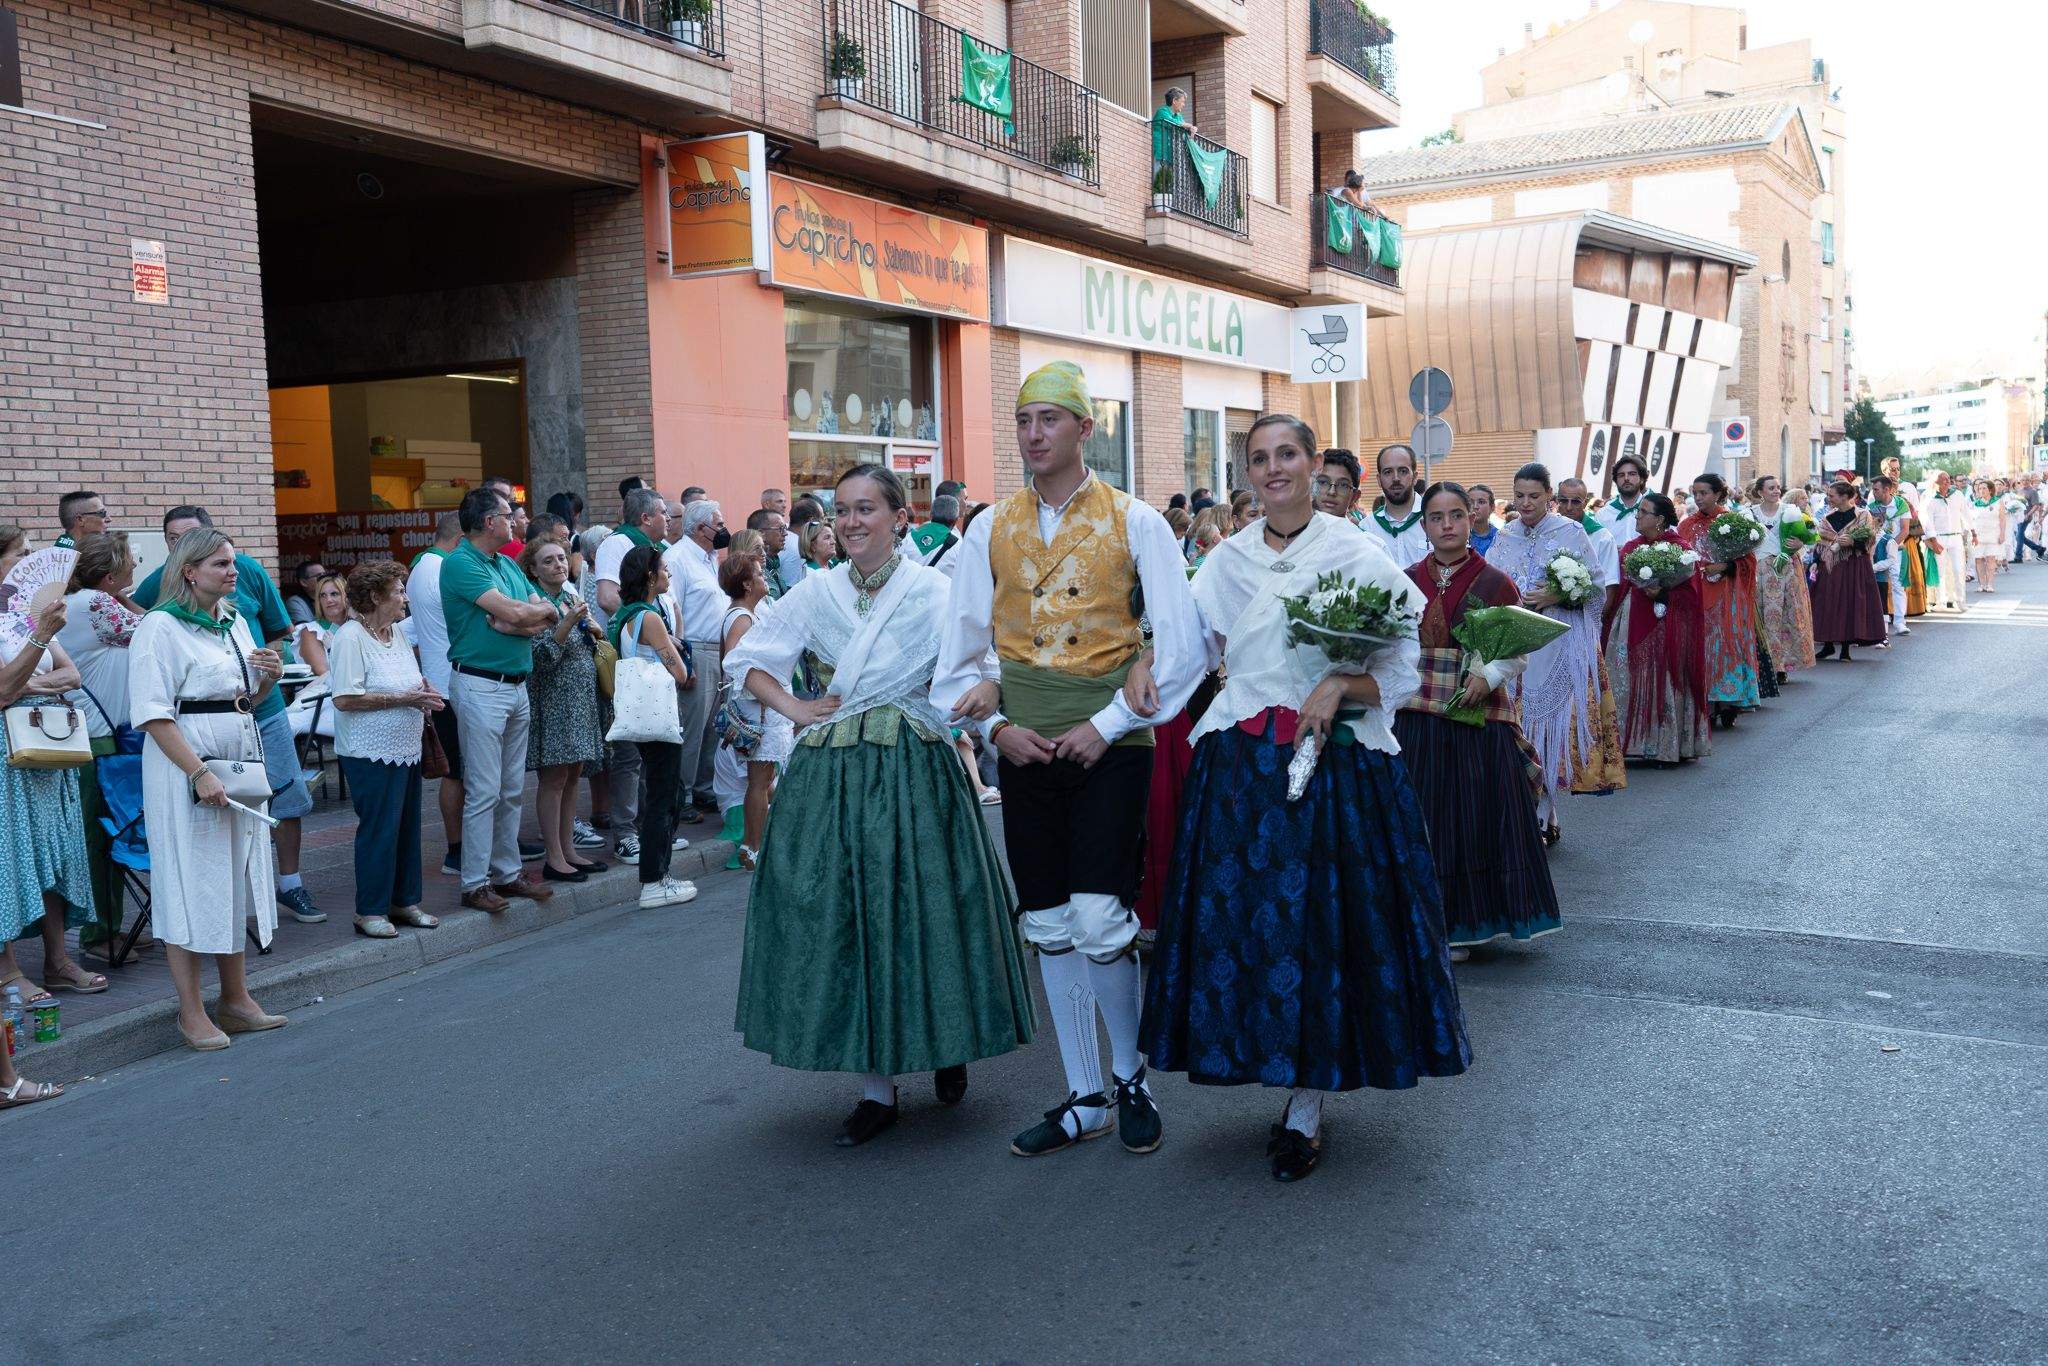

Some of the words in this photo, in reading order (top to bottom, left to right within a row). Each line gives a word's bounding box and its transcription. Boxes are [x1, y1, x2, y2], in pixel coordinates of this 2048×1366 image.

[669, 180, 751, 213] Capricho
[773, 204, 876, 267] Capricho
[136, 265, 165, 275] Alarma
[883, 239, 923, 277] Sabemos
[924, 248, 933, 277] lo
[934, 256, 949, 285] que
[950, 256, 960, 284] te
[1085, 266, 1243, 357] MICAELA
[327, 532, 390, 551] gominolas
